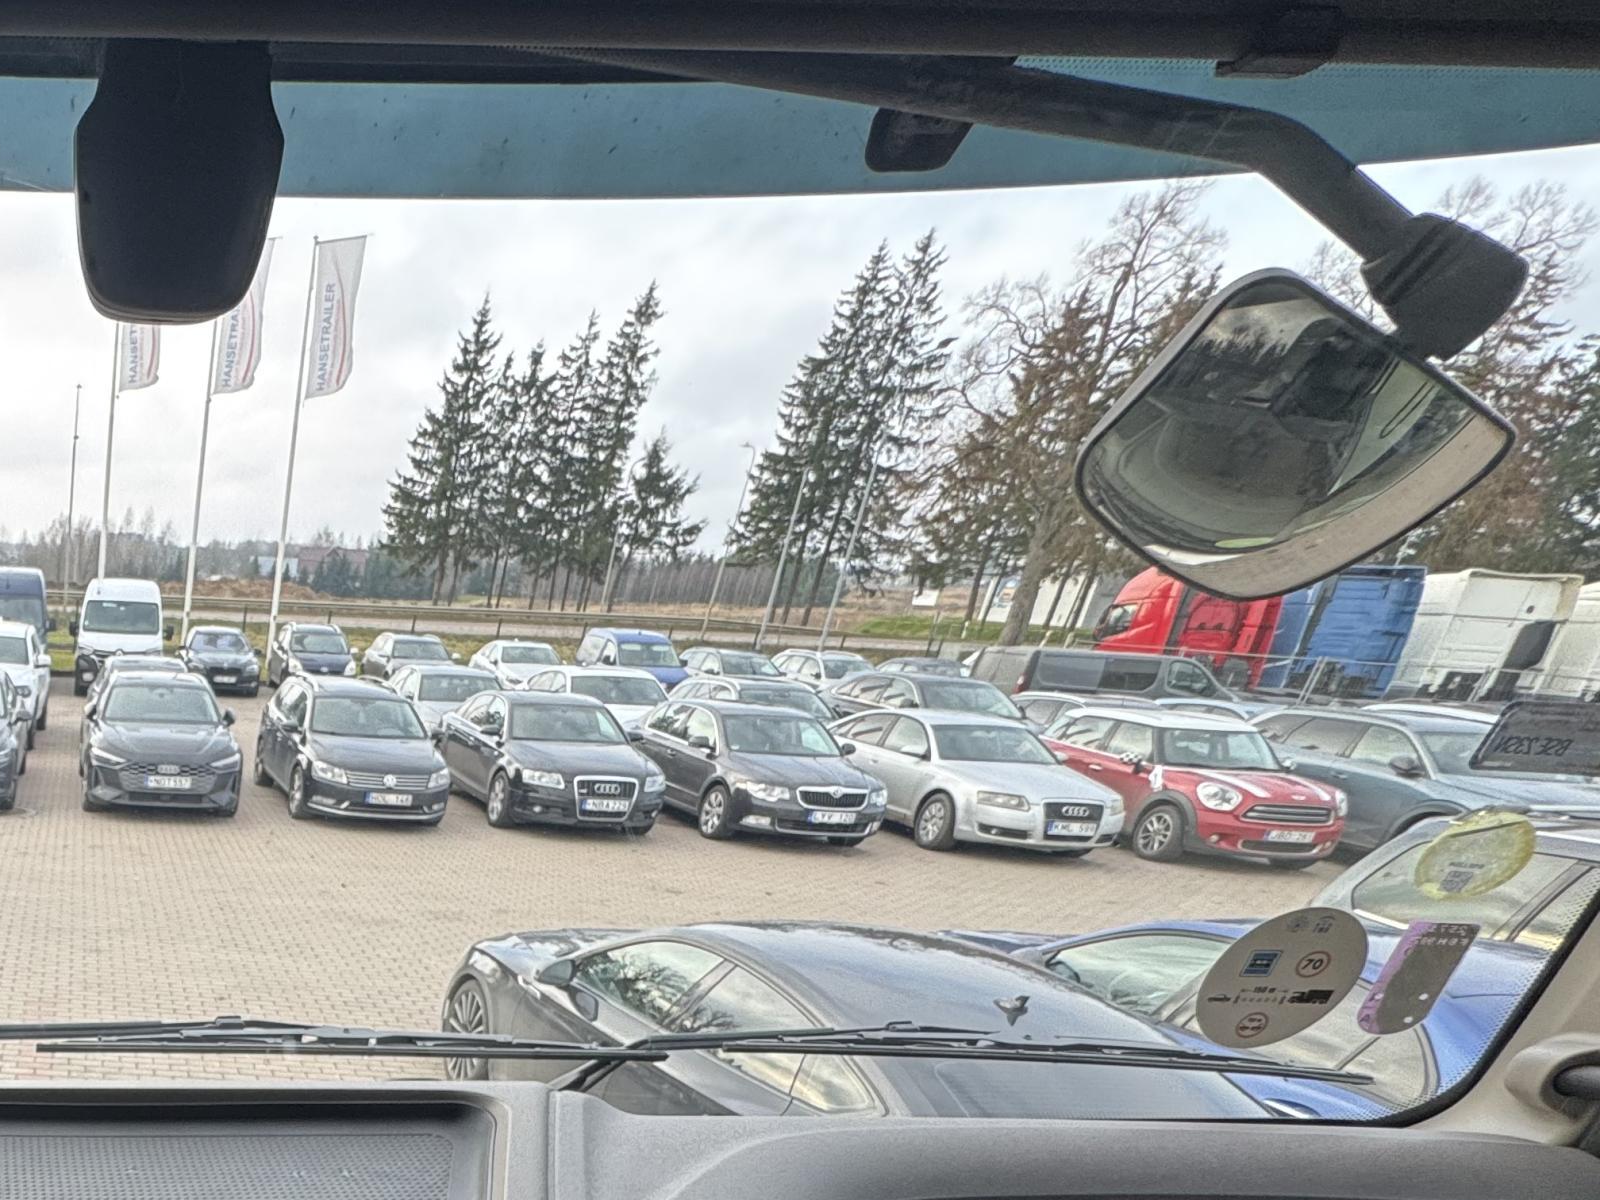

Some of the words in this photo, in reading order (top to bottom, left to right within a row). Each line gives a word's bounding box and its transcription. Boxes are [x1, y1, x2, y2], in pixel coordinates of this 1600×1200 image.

[128, 323, 140, 385] HANSET
[222, 305, 241, 389] HANSETRA
[316, 282, 336, 392] HANSETRAILER
[1301, 958, 1323, 971] 70
